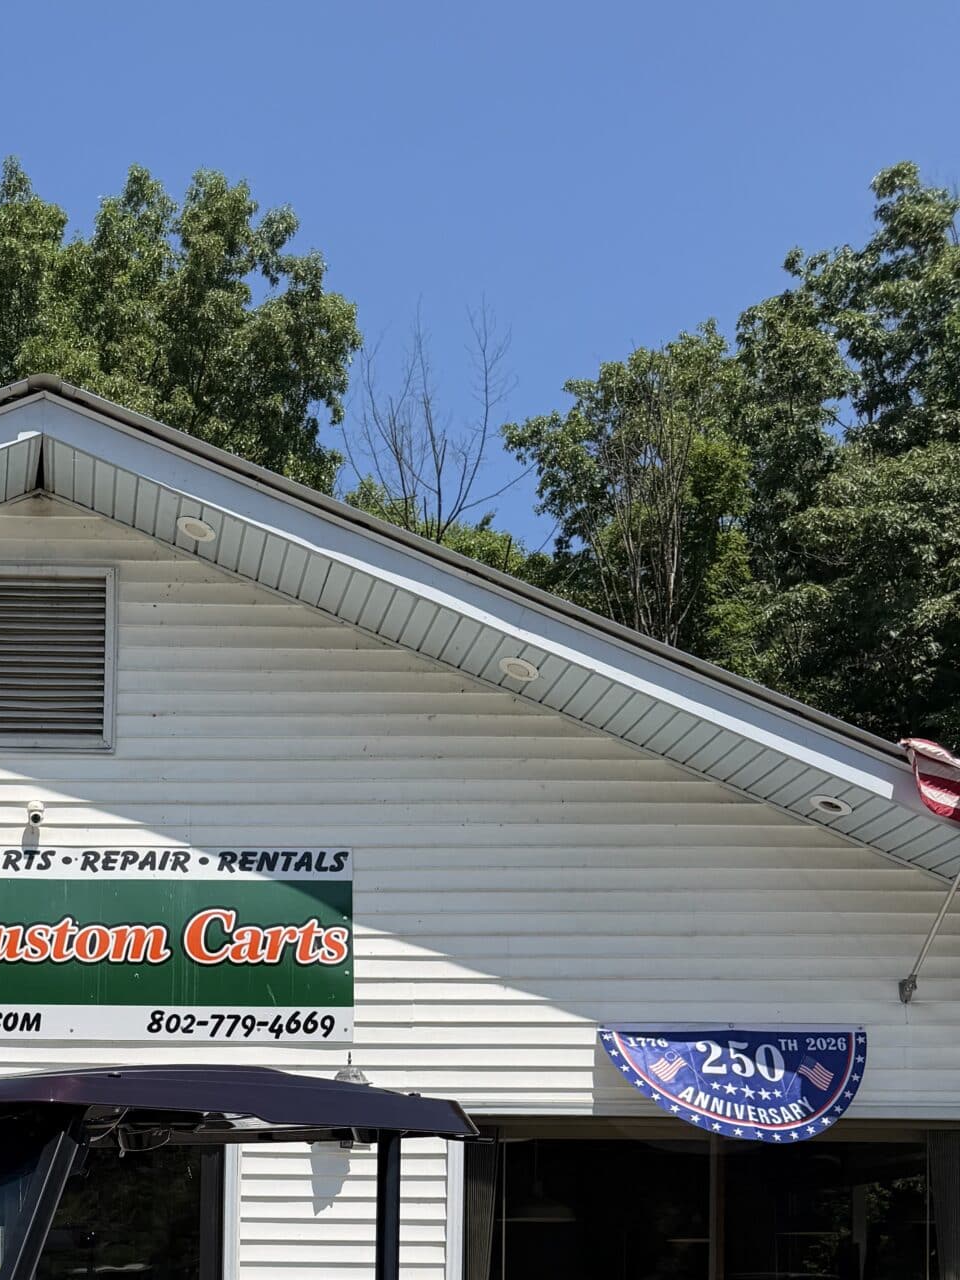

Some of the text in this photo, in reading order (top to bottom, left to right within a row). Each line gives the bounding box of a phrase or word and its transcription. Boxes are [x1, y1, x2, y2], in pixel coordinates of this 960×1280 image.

[80, 850, 191, 873] REPAIR
[217, 851, 349, 874] RENTALS
[183, 908, 349, 965] Carts
[146, 1010, 336, 1039] 802-779-4669
[627, 1037, 669, 1049] 1776
[805, 1037, 847, 1051] 2026
[678, 1086, 815, 1125] ANNIVERSARY
